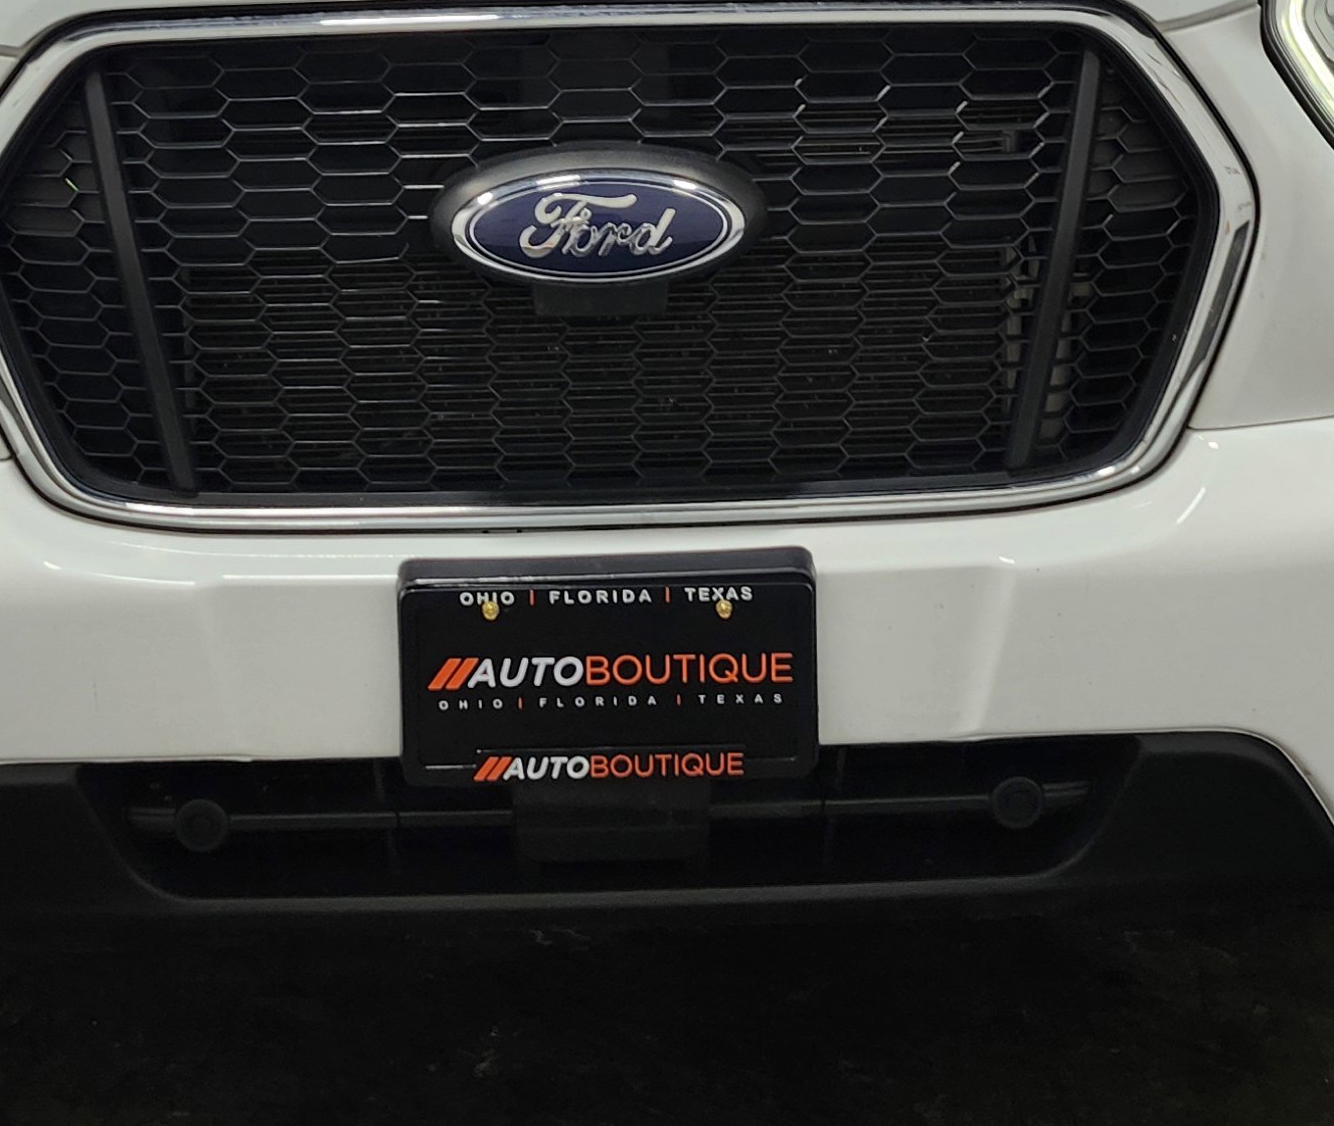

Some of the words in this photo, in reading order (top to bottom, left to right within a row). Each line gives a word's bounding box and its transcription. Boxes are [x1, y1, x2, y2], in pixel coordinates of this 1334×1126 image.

[519, 192, 676, 258] Ford
[459, 591, 515, 606] OHIO
[549, 589, 652, 605] FLORIDA
[684, 586, 753, 602] TEXAS
[467, 652, 794, 688] AUTOBOUTIQUE
[438, 698, 503, 711] OHIO
[539, 695, 657, 708] FLORIDA
[698, 693, 783, 705] TEXAS
[502, 752, 745, 780] AUTOBOUTIQUE
